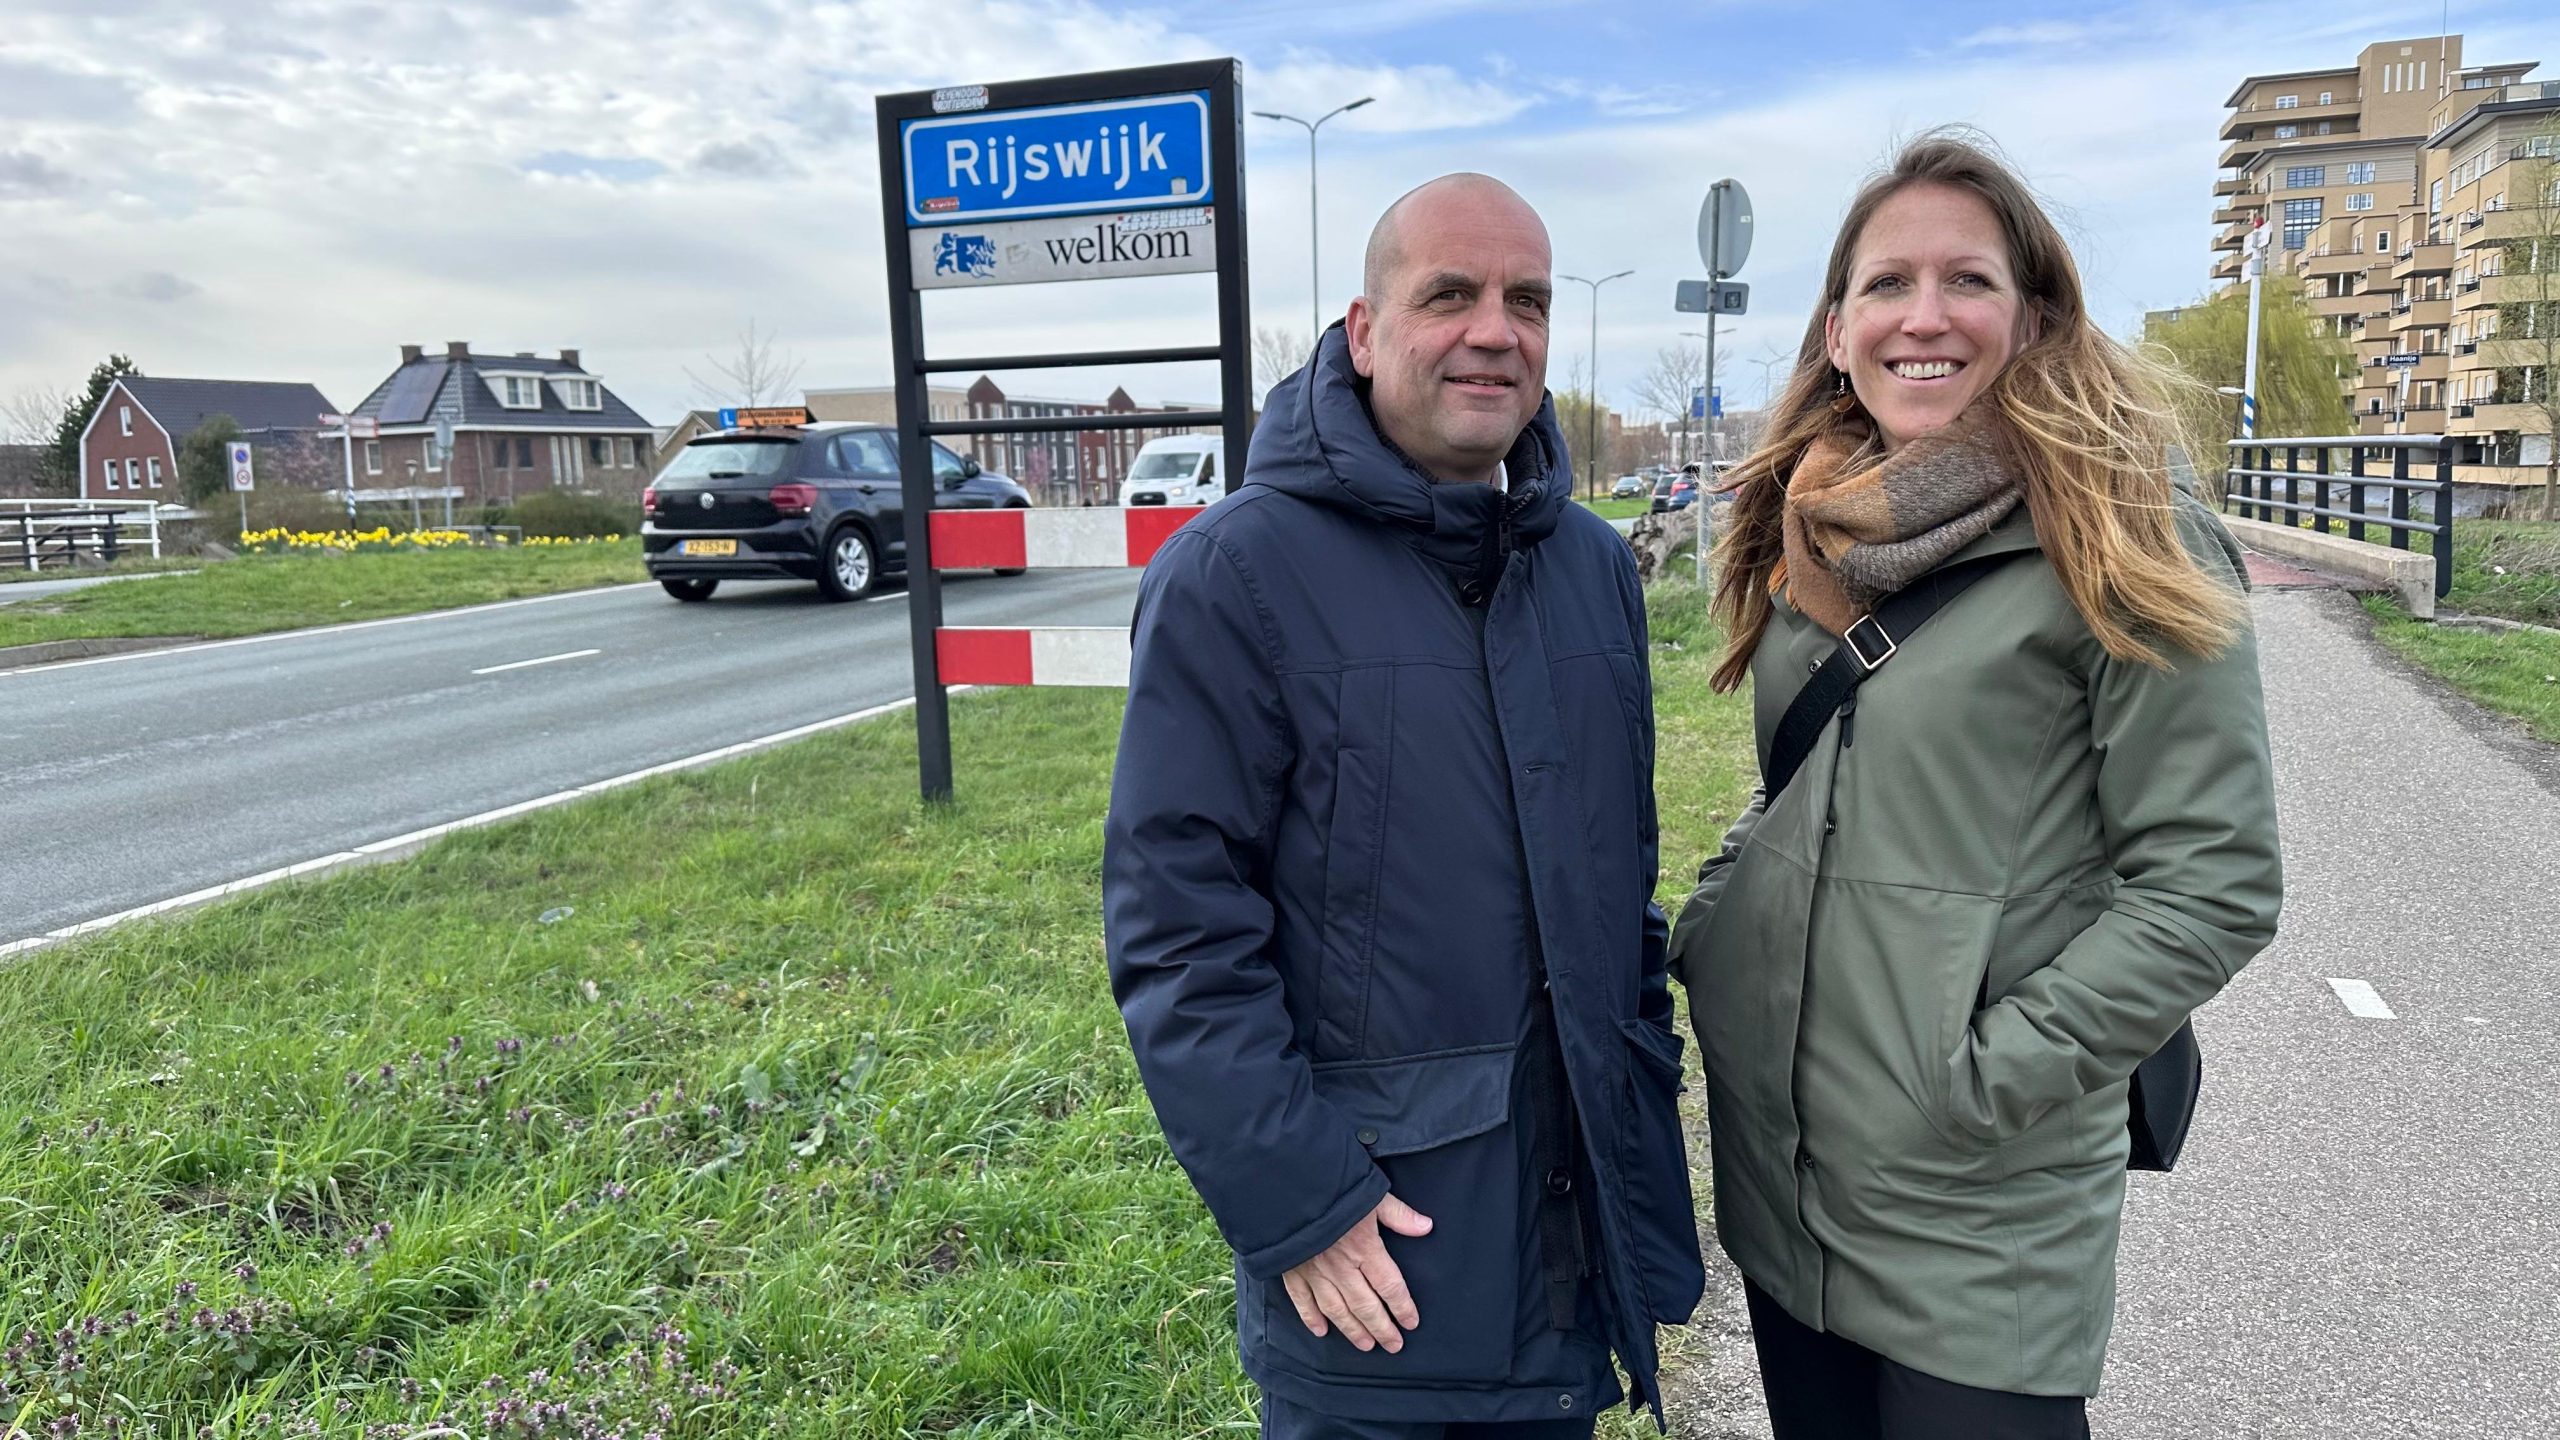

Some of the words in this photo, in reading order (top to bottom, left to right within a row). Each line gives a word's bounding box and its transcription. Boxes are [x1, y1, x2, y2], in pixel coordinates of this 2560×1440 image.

[946, 121, 1167, 199] Rijswijk
[1045, 225, 1190, 265] welkom
[723, 411, 734, 426] L
